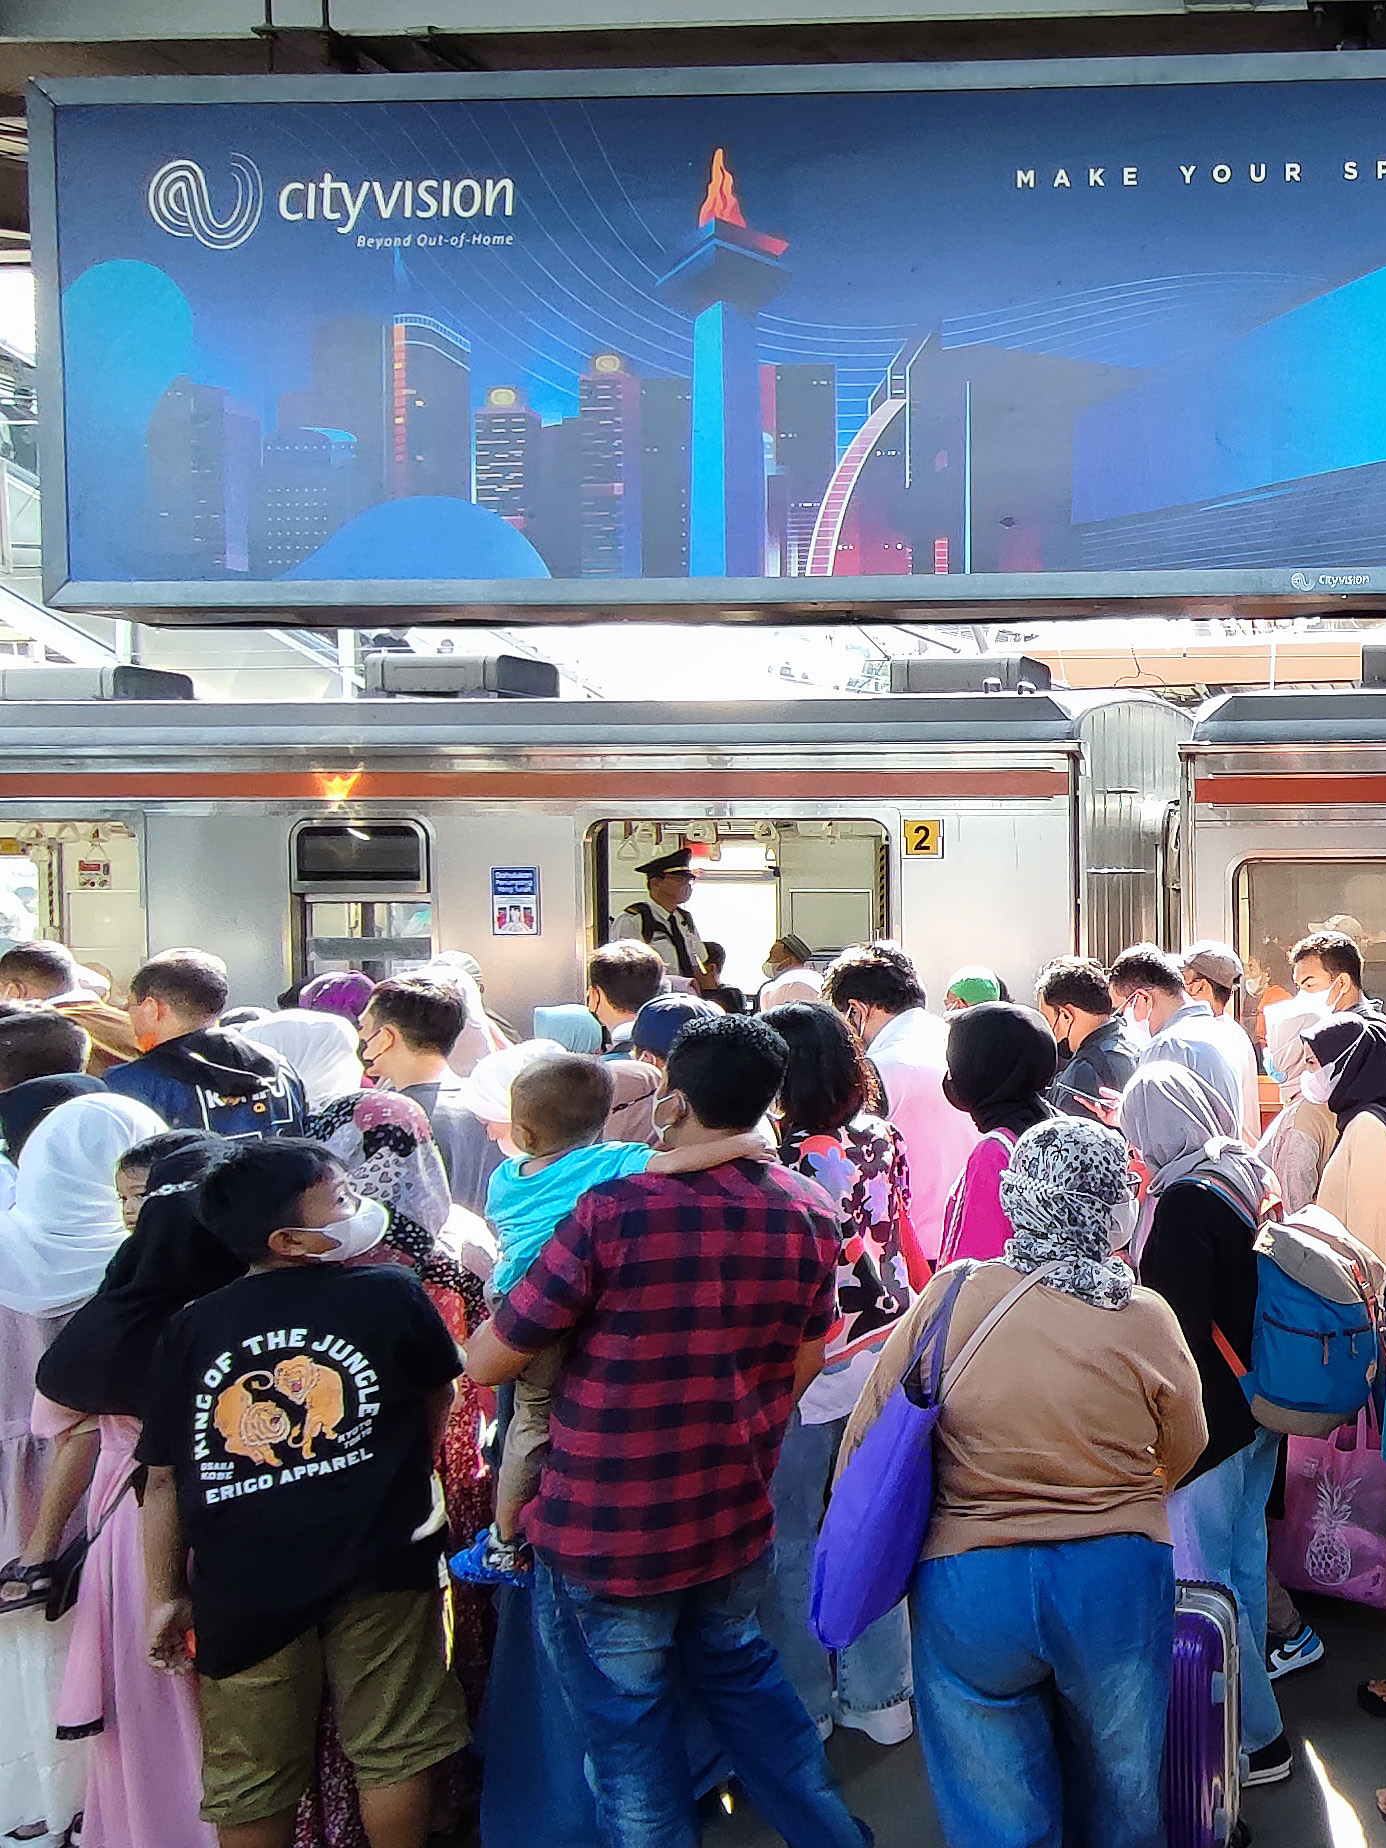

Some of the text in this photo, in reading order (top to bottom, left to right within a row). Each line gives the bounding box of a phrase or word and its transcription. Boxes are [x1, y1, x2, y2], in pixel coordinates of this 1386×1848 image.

[1016, 167, 1138, 188] MAKE
[1180, 163, 1302, 184] YOUR
[279, 172, 514, 234] cityvision
[357, 233, 514, 250] Beyond Out-of-Home
[914, 826, 930, 850] 2
[194, 1328, 381, 1461] KING OF THE JUNGLE
[205, 1448, 374, 1505] ERIGO APPAREL
